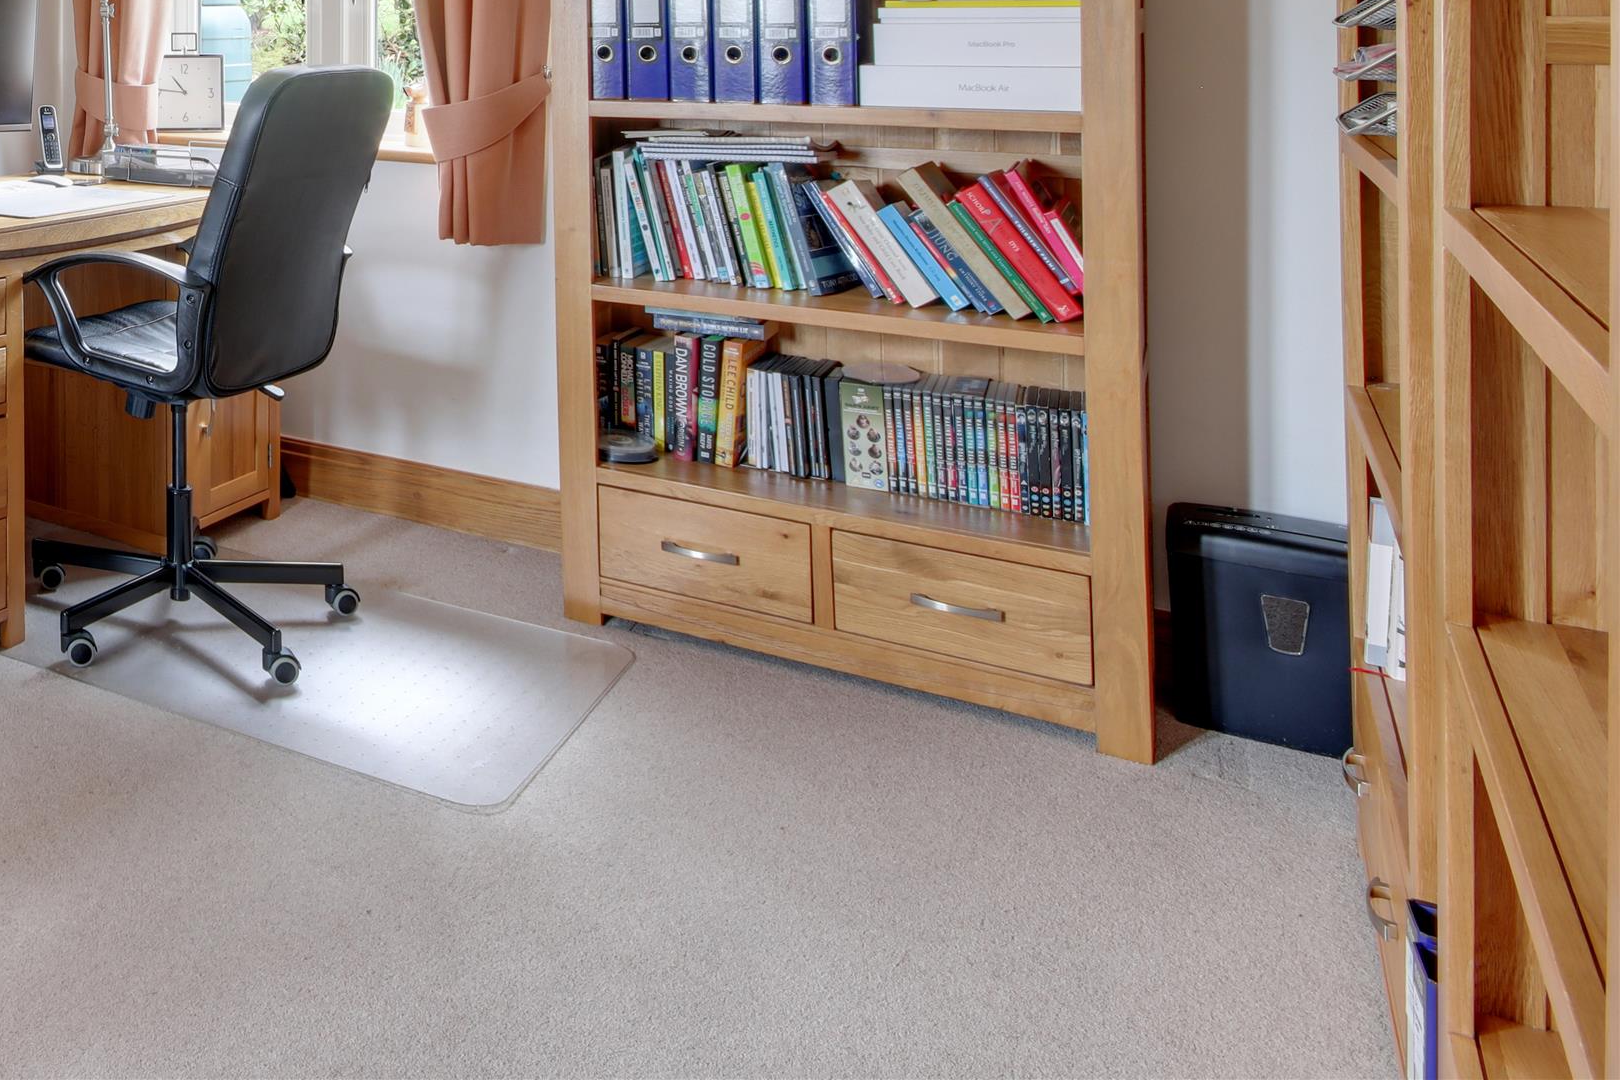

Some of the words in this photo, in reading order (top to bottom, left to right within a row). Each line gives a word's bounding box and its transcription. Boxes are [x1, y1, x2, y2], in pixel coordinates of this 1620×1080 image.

[967, 40, 1002, 48] MacBook
[1002, 40, 1016, 48] Pro
[180, 63, 189, 75] 12
[207, 87, 215, 99] 3
[957, 83, 996, 93] MacBook
[997, 83, 1011, 93] Air
[182, 111, 189, 122] 6
[931, 232, 958, 261] JUNG
[675, 347, 687, 373] DAN
[703, 344, 715, 373] COLD
[727, 359, 736, 377] LEE
[675, 373, 688, 418] BROWN
[701, 376, 713, 425] STORAGE
[725, 379, 735, 410] CHILD
[1008, 424, 1016, 445] WAKING
